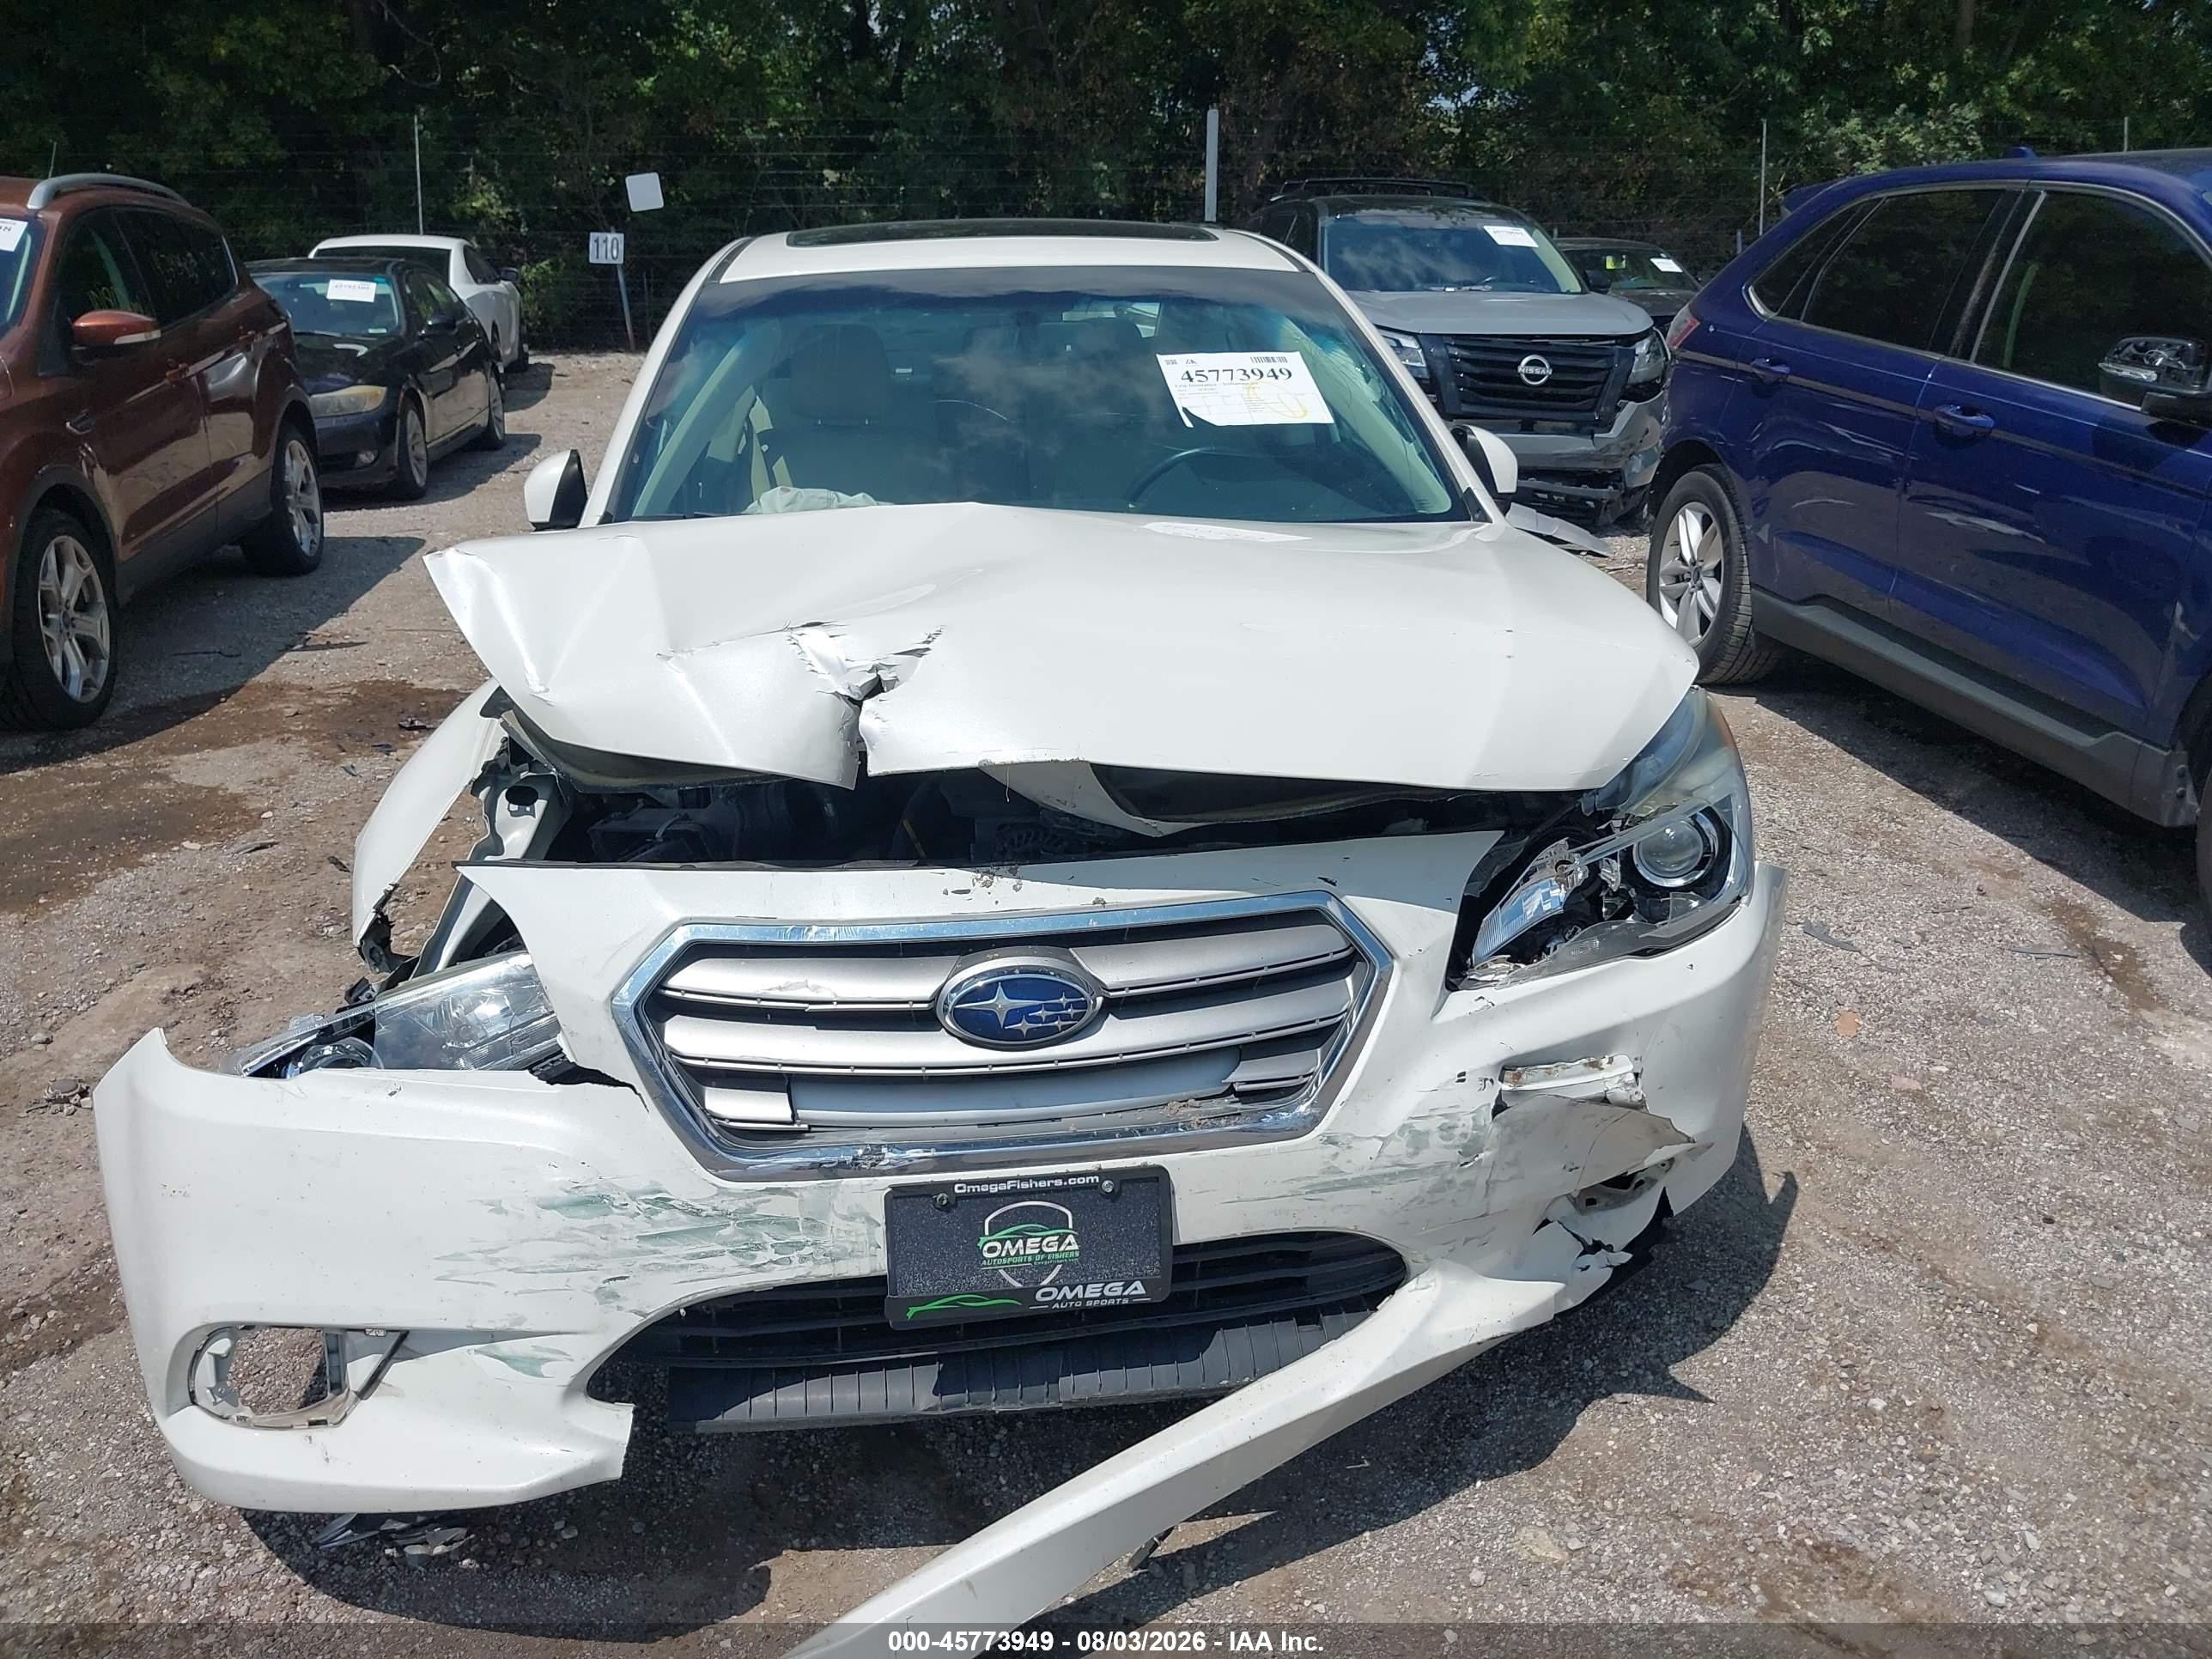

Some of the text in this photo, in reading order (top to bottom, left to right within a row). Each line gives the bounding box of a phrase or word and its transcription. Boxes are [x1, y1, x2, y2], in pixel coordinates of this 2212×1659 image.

[593, 236, 619, 260] 110
[1181, 368, 1292, 383] 45773949
[1517, 366, 1553, 375] NISSAN
[954, 1175, 1100, 1194] OmegaFishers.com
[982, 1234, 1079, 1259] OMEGA
[981, 1255, 1032, 1266] AUTOSPORTS
[1048, 1251, 1080, 1260] FISHERS
[1035, 1280, 1146, 1302] OMEGA
[1051, 1297, 1129, 1310] AUTO SPORTS
